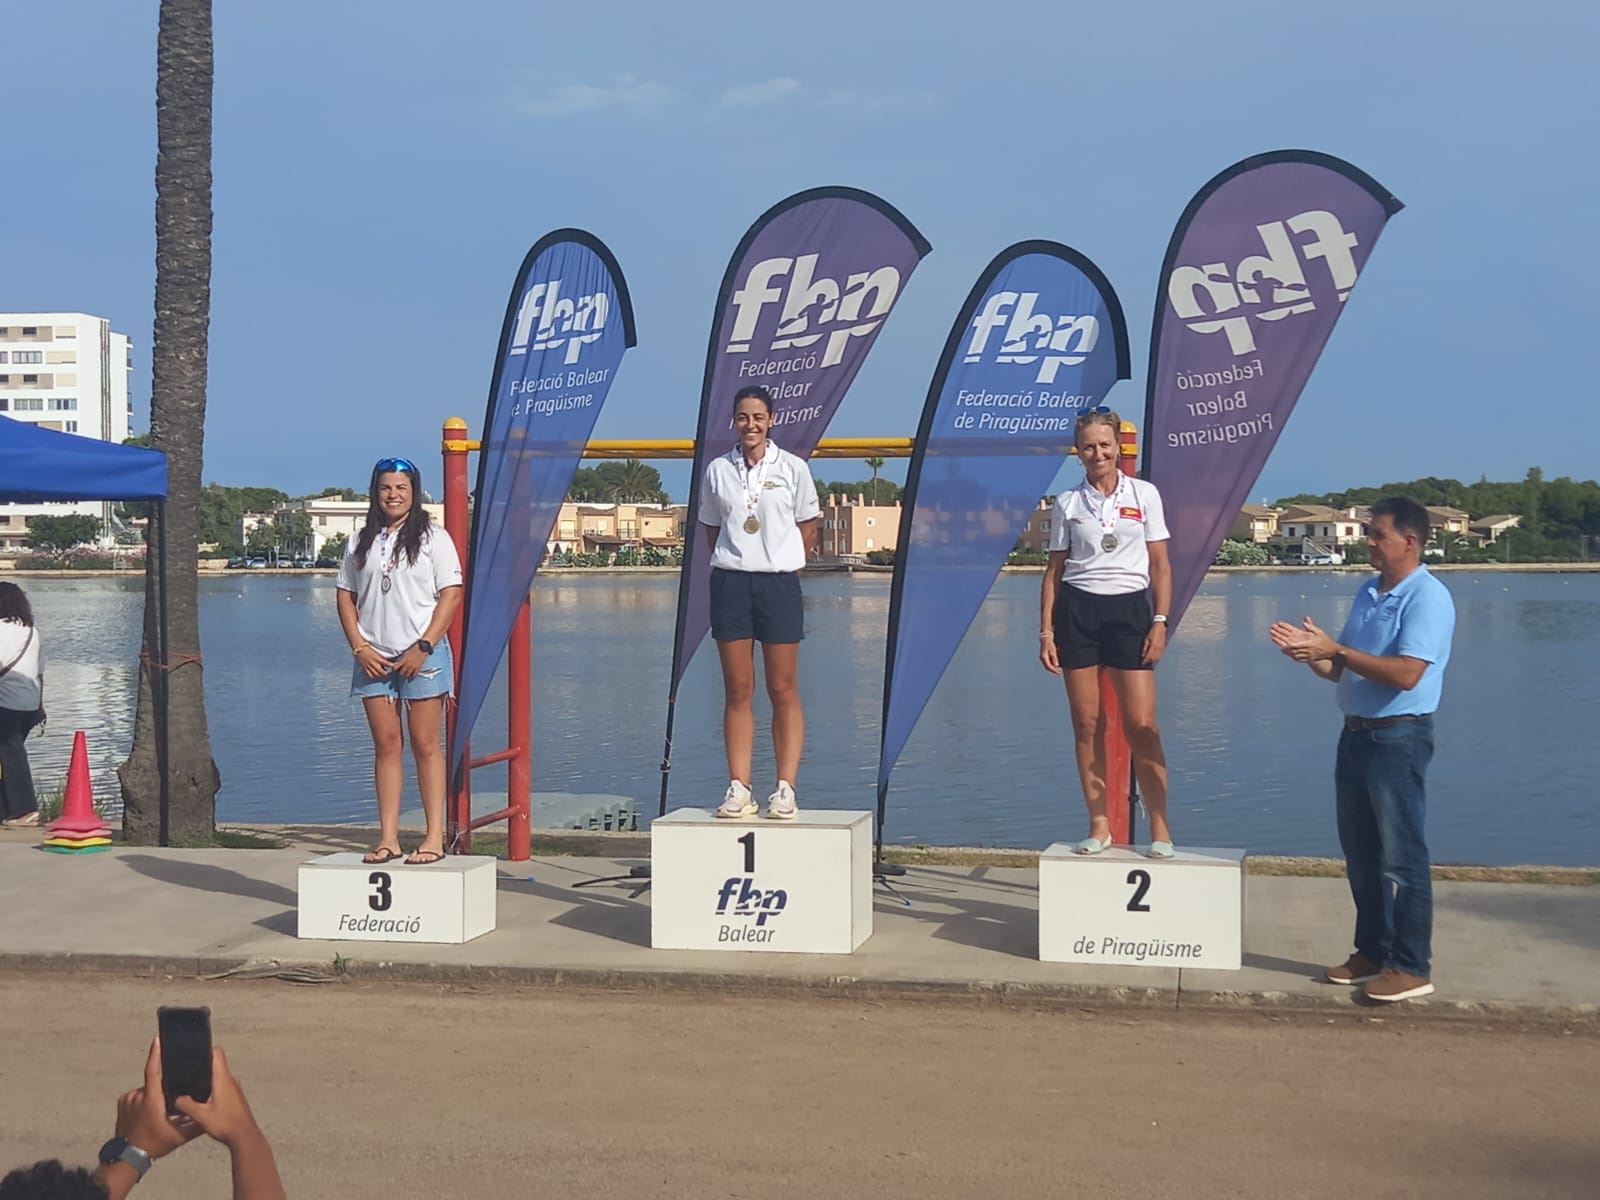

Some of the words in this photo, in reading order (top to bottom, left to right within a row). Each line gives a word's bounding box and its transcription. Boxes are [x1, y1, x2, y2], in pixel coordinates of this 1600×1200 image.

[510, 279, 609, 365] fbp
[725, 253, 901, 368] fbp
[963, 291, 1100, 384] fbp
[567, 367, 610, 388] Balear
[738, 351, 817, 378] Federació
[524, 393, 594, 417] Pragüisme
[956, 389, 1034, 408] Federació
[1037, 391, 1093, 409] Balear
[954, 411, 975, 429] de
[978, 412, 1070, 434] Piragüisme
[737, 831, 755, 873] 1
[368, 871, 392, 912] 3
[715, 877, 788, 926] fbp
[1126, 869, 1152, 912] 2
[338, 913, 421, 934] Federació
[718, 924, 776, 943] Balear
[1073, 936, 1096, 954] de
[1100, 937, 1203, 961] Piragüisme
